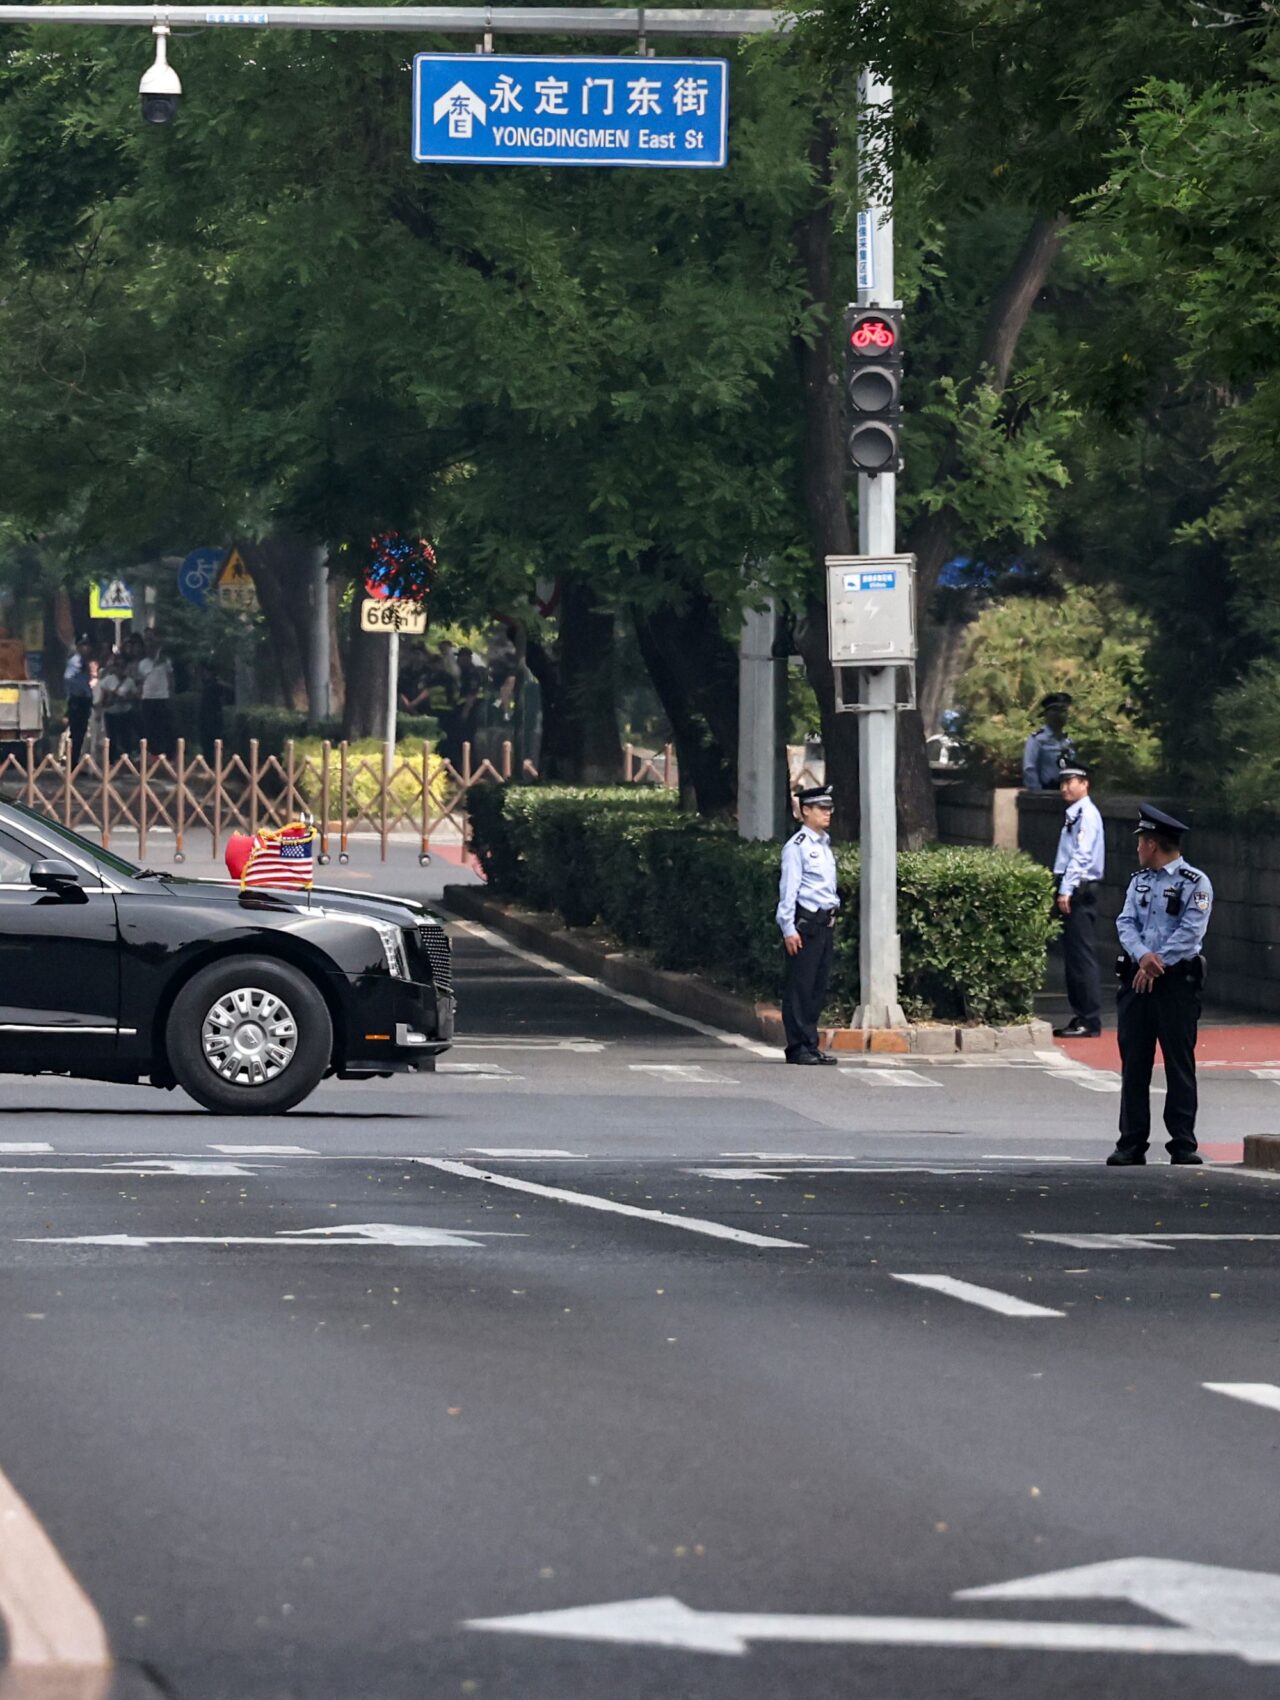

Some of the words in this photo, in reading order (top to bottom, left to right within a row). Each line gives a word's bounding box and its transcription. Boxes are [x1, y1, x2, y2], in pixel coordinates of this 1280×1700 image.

[449, 95, 471, 116] 东
[489, 74, 709, 116] 永定门东街
[454, 119, 467, 134] E
[491, 126, 629, 148] YONGDINGMEN
[639, 129, 676, 149] East
[685, 129, 704, 149] St
